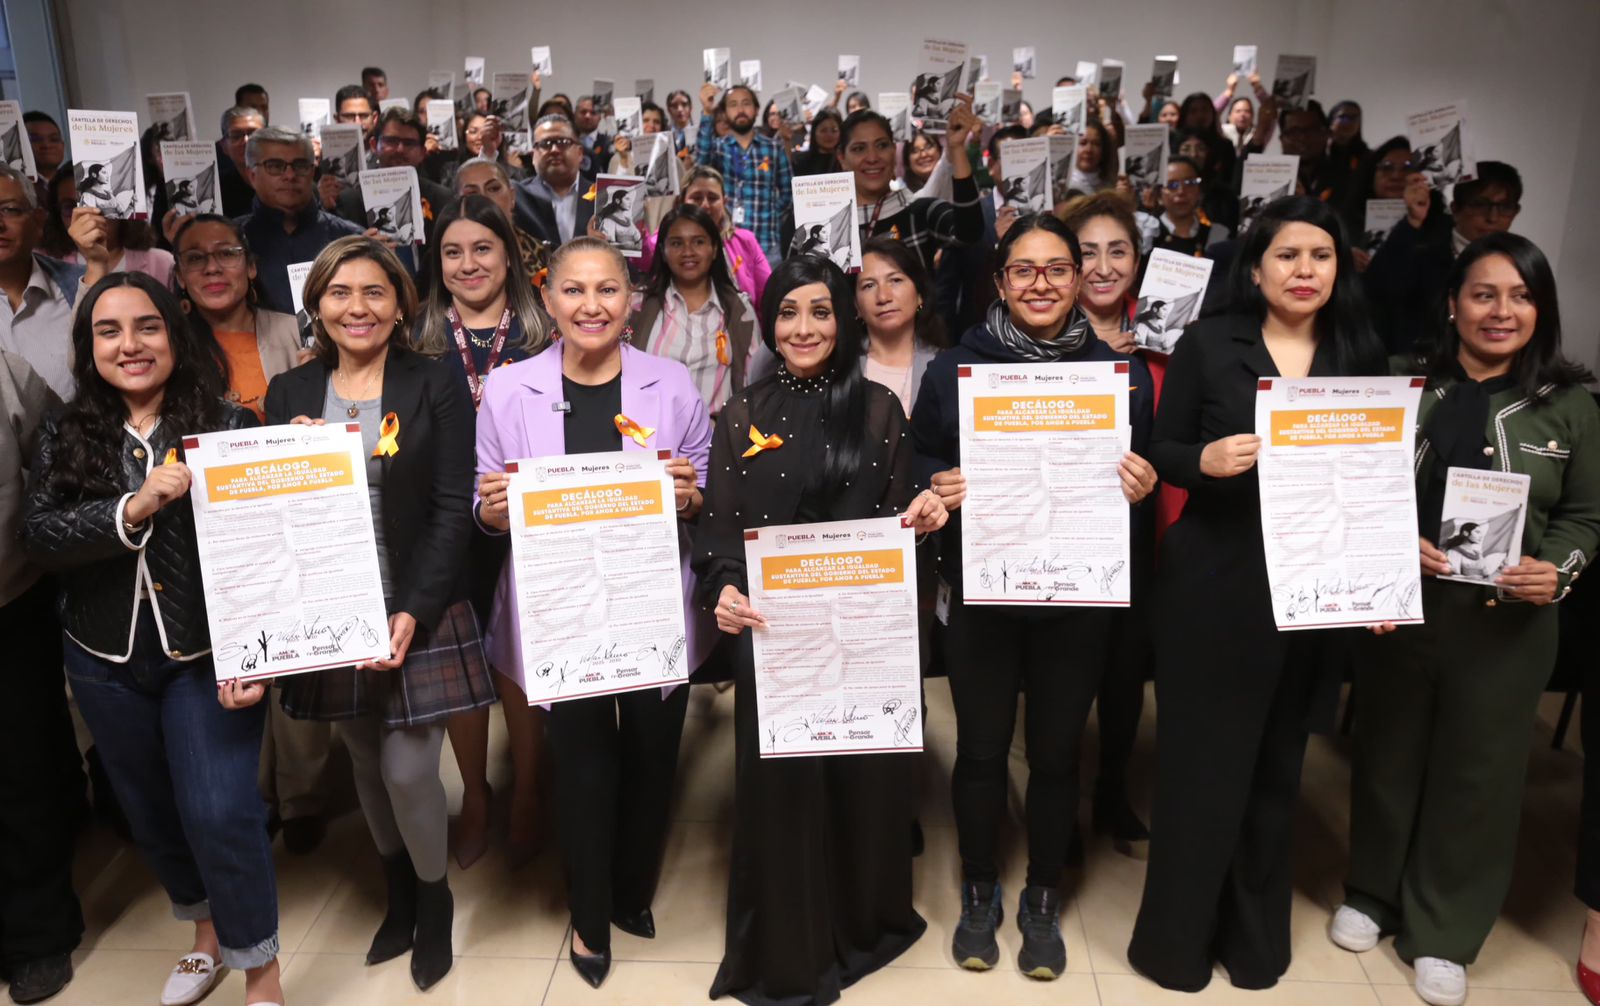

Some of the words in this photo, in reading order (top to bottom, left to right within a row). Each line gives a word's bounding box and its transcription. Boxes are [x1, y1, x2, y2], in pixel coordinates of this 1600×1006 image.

[99, 124, 133, 133] Mujeres
[820, 185, 849, 194] Mujeres
[1012, 399, 1074, 409] DECÁLOGO
[1307, 412, 1365, 422] DECÁLOGO
[230, 440, 258, 448] PUEBLA
[265, 437, 295, 446] Mujeres
[246, 460, 309, 475] DECÁLOGO
[1483, 482, 1522, 494] Mujeres
[561, 488, 622, 501] DECÁLOGO
[800, 556, 862, 566] DECÁLOGO
[272, 653, 299, 661] PUEBLA
[579, 675, 604, 683] PUEBLA
